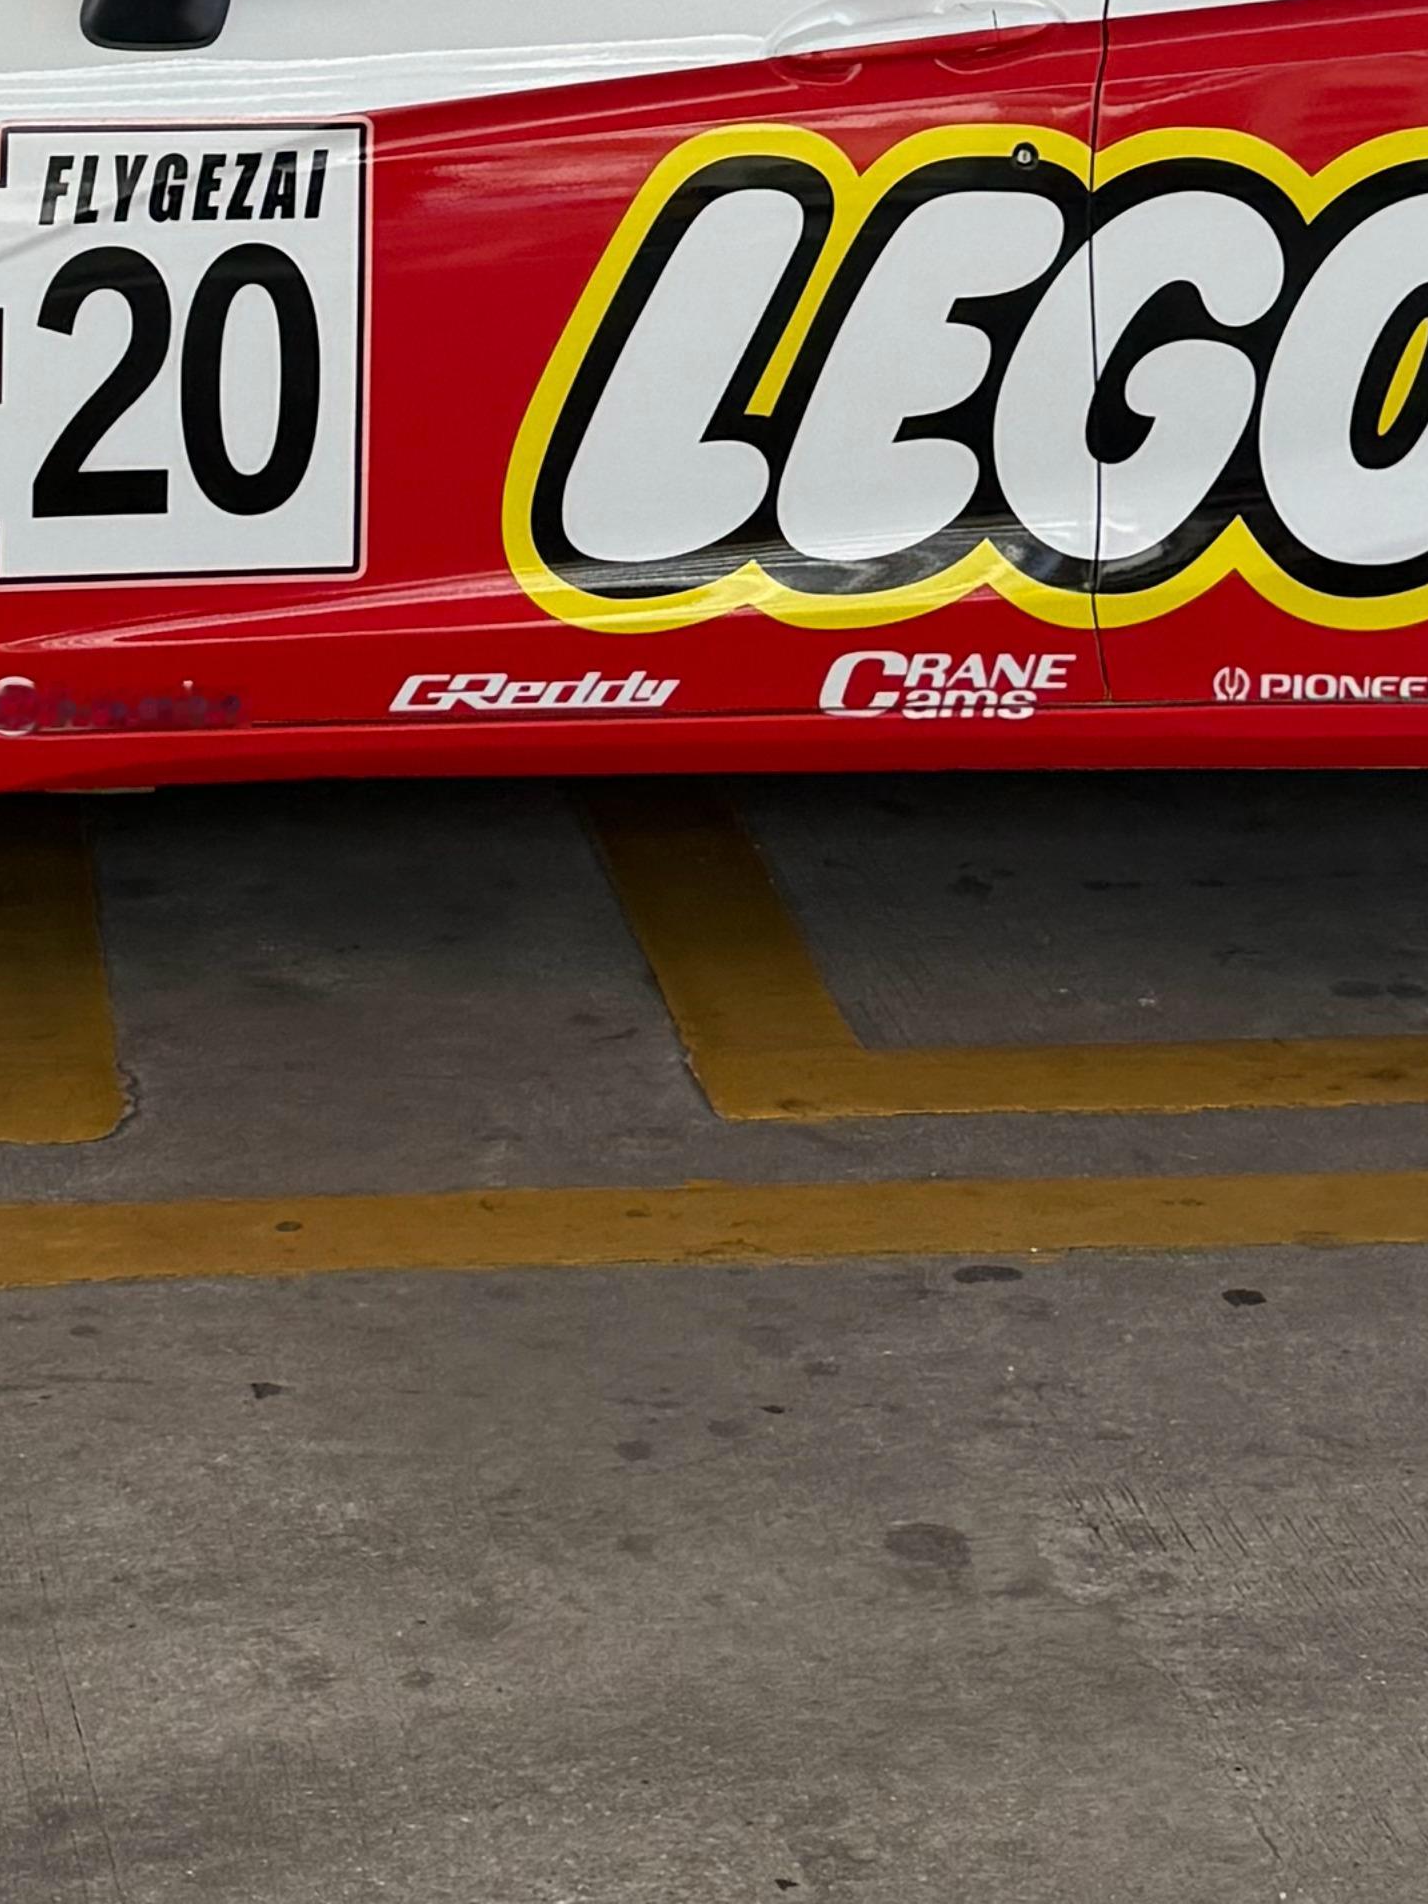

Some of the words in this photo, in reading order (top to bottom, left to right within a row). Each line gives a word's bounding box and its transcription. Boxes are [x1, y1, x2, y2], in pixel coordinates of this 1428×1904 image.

[39, 149, 329, 226] FLYGEZAI
[32, 242, 320, 518] 20
[818, 651, 1076, 719] CRANE
